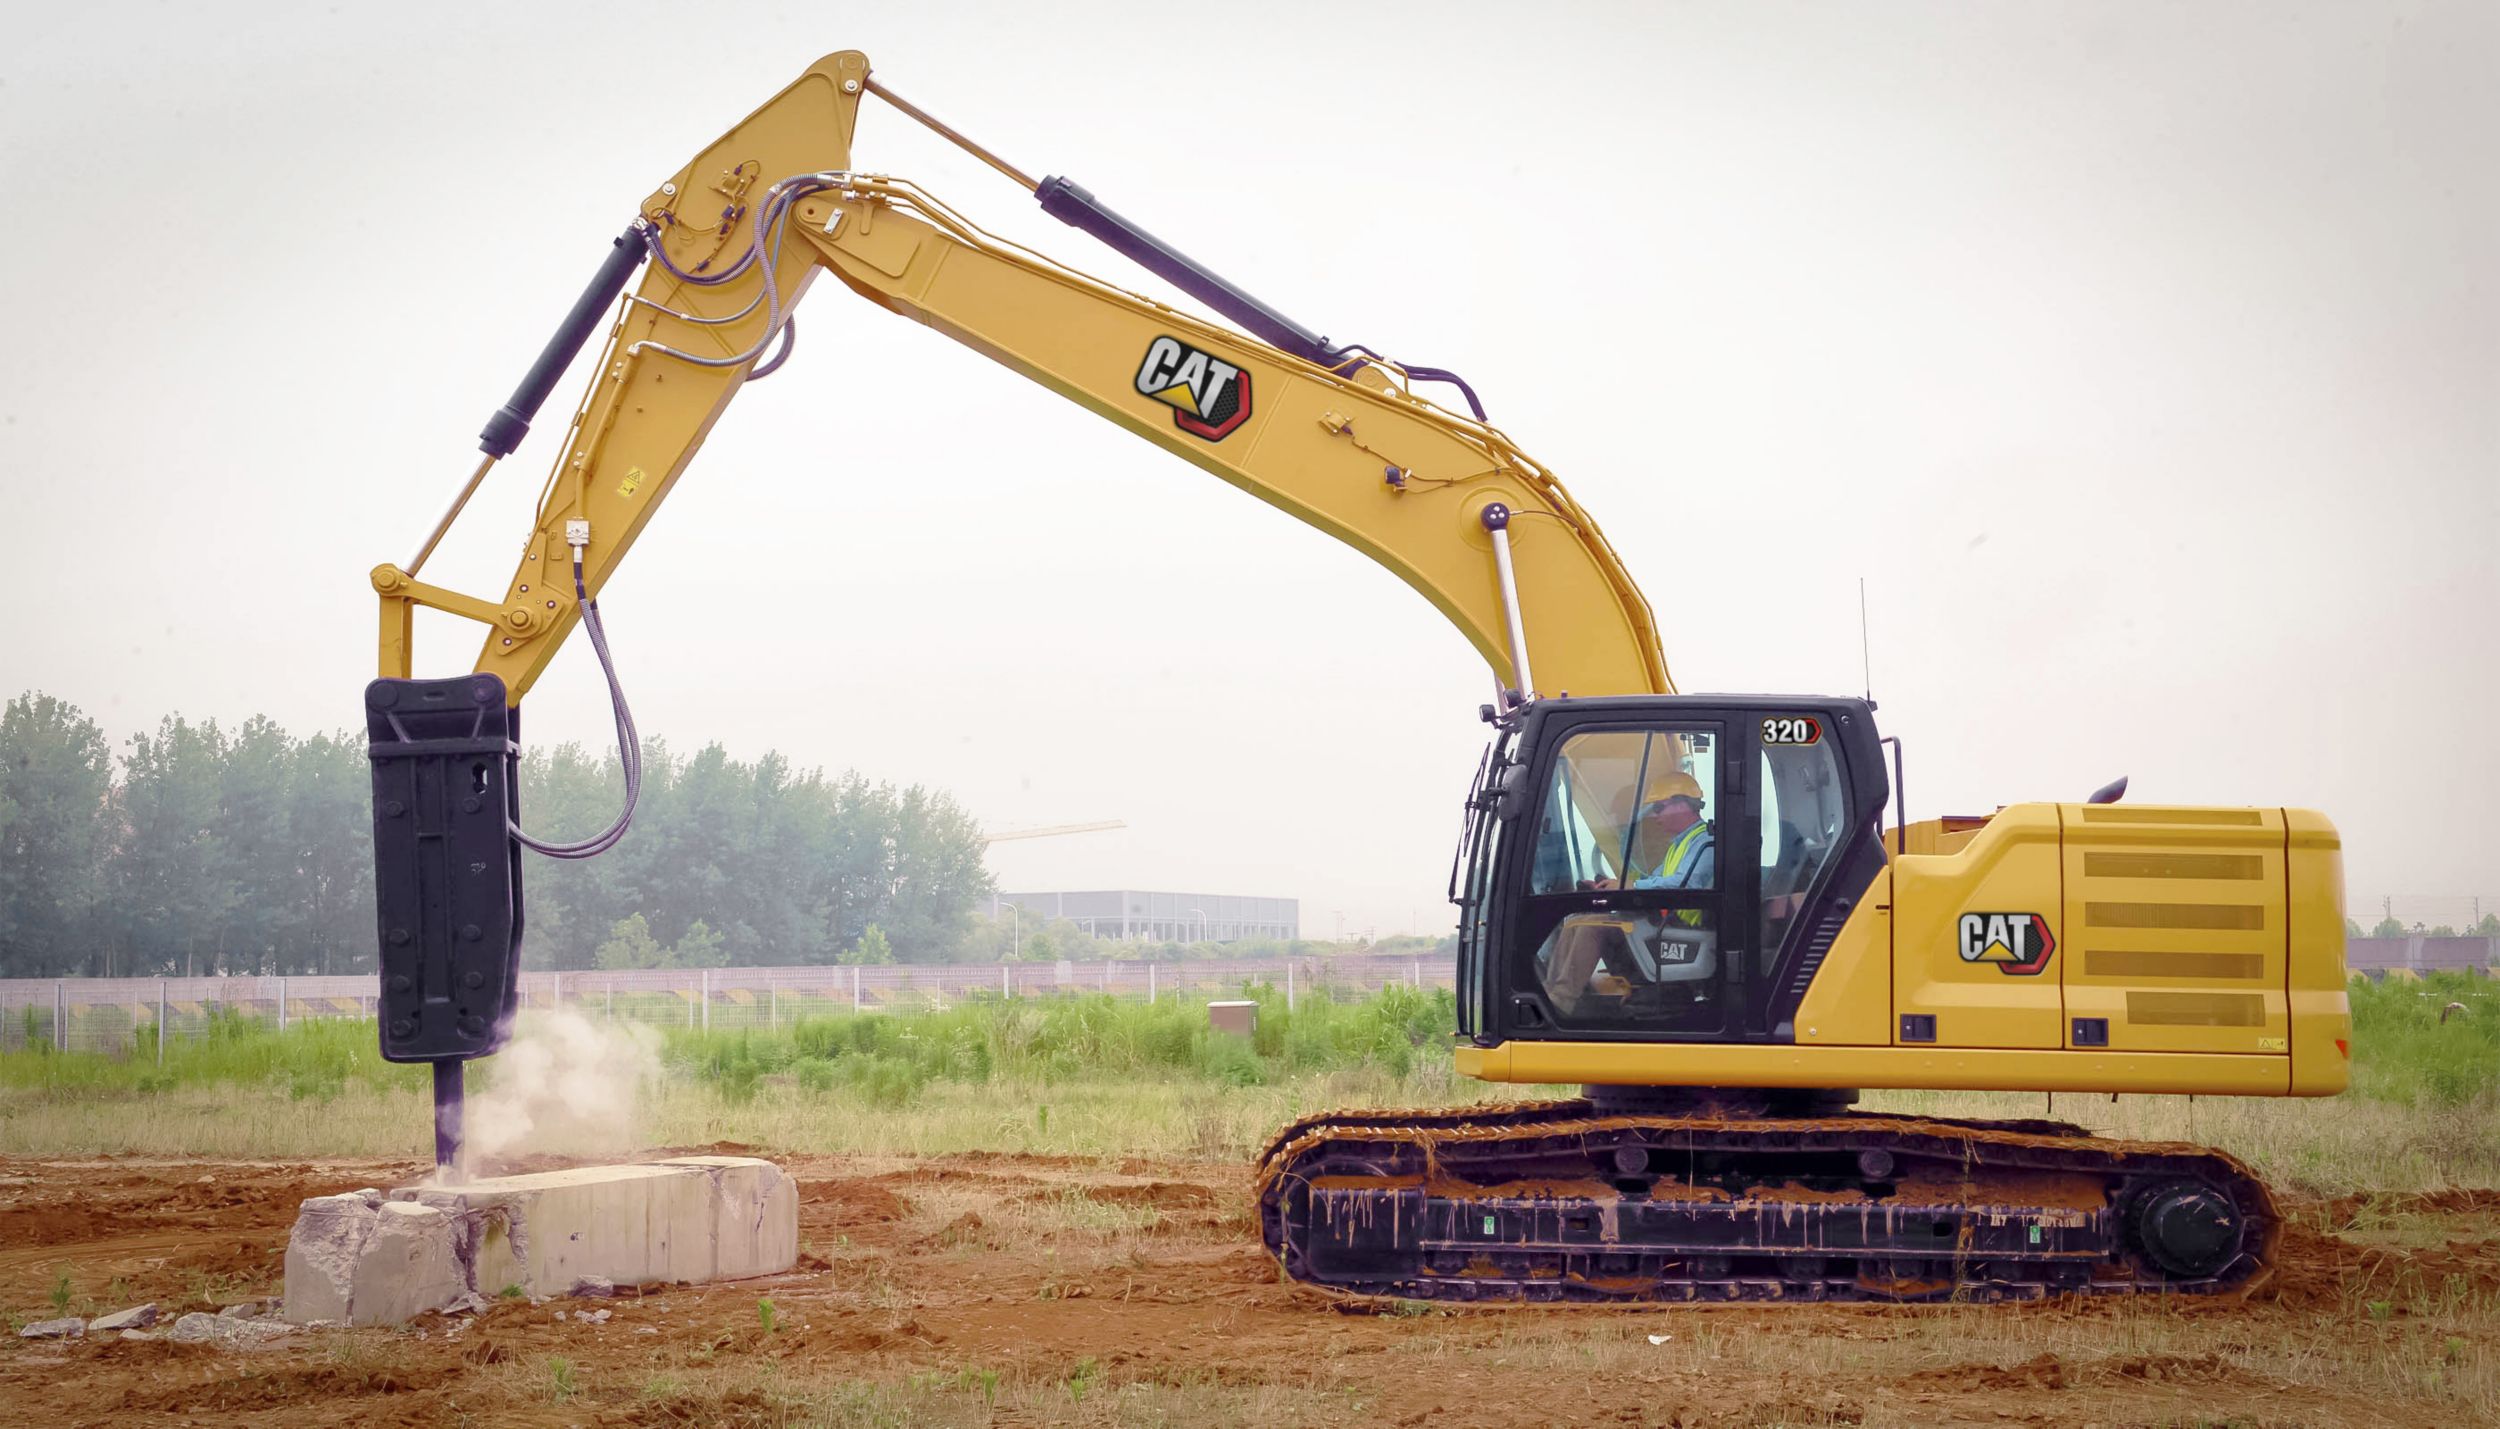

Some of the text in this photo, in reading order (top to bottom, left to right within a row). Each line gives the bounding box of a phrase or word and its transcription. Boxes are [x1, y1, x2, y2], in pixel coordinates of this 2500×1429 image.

[1137, 337, 1239, 419] CAT
[1763, 719, 1808, 743] 320
[1660, 942, 1688, 960] CAT
[1960, 914, 2031, 961] CAT
